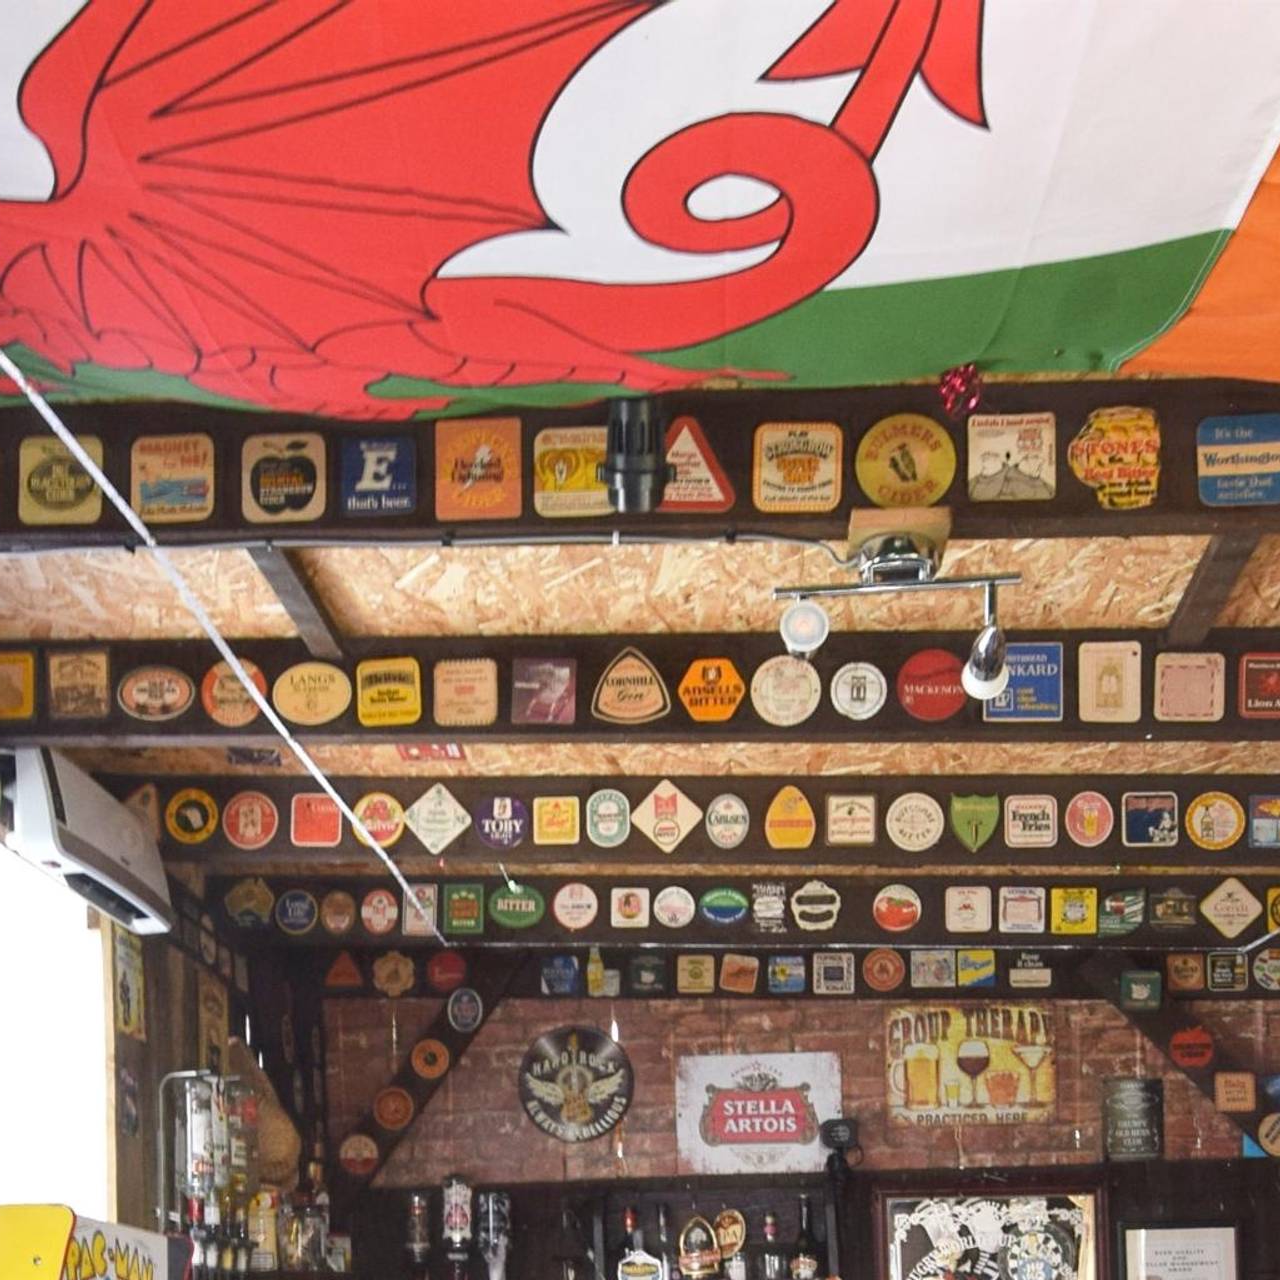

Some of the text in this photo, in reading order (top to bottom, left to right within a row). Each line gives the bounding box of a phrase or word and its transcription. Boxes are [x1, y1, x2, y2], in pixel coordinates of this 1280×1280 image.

[1073, 439, 1157, 453] STONES
[1007, 664, 1059, 677] NKARD
[1010, 810, 1050, 822] French
[481, 818, 524, 833] TOBY
[1021, 821, 1051, 833] Fries
[888, 1007, 1056, 1059] GROUP THERAPY
[722, 1099, 796, 1116] STELLA
[995, 1111, 1029, 1123] HERE
[723, 1117, 797, 1134] ARTOIS
